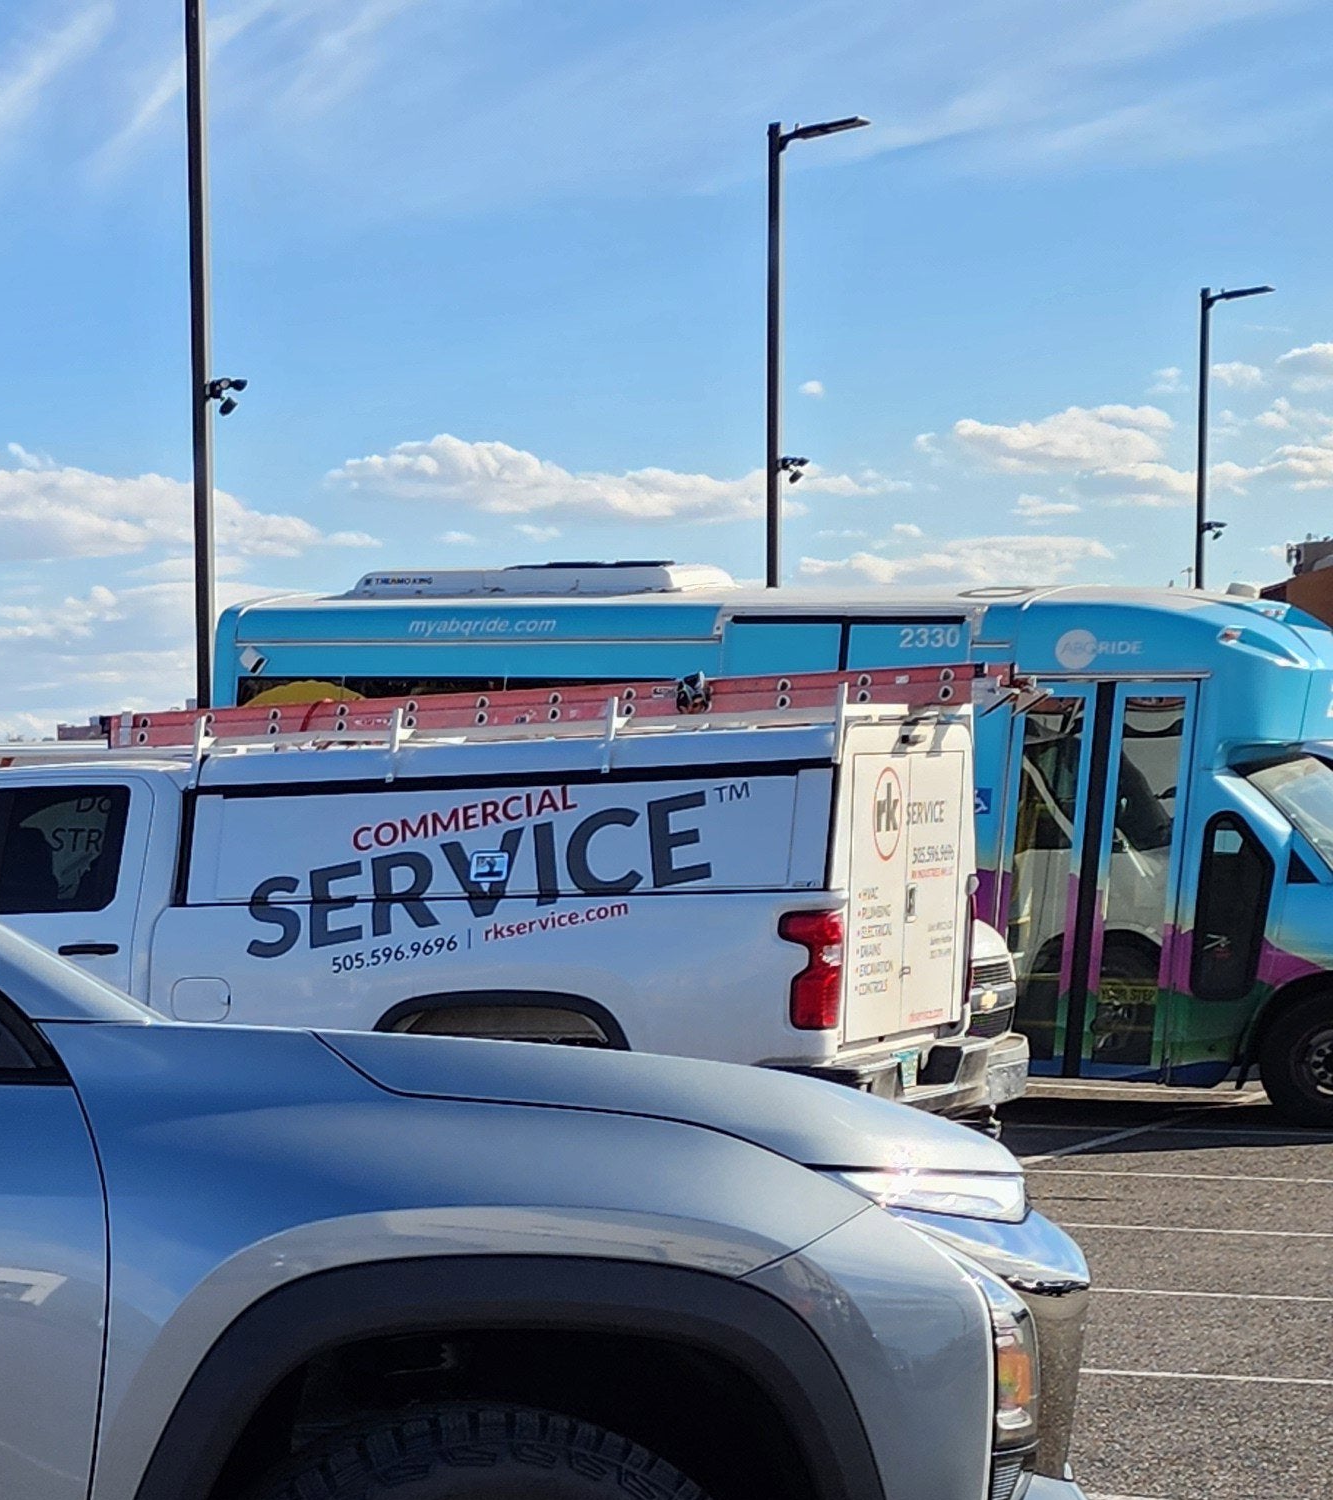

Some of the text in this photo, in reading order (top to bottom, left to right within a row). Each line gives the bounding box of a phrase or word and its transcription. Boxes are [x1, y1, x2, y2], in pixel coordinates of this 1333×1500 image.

[408, 616, 557, 637] myabqride.com
[899, 627, 960, 648] 2330
[352, 785, 577, 851] COMMERCIAL
[876, 782, 945, 832] rk SERVICE
[246, 781, 750, 958] SERVICE TM
[332, 902, 629, 974] 505.596.9696 rkservice.com
